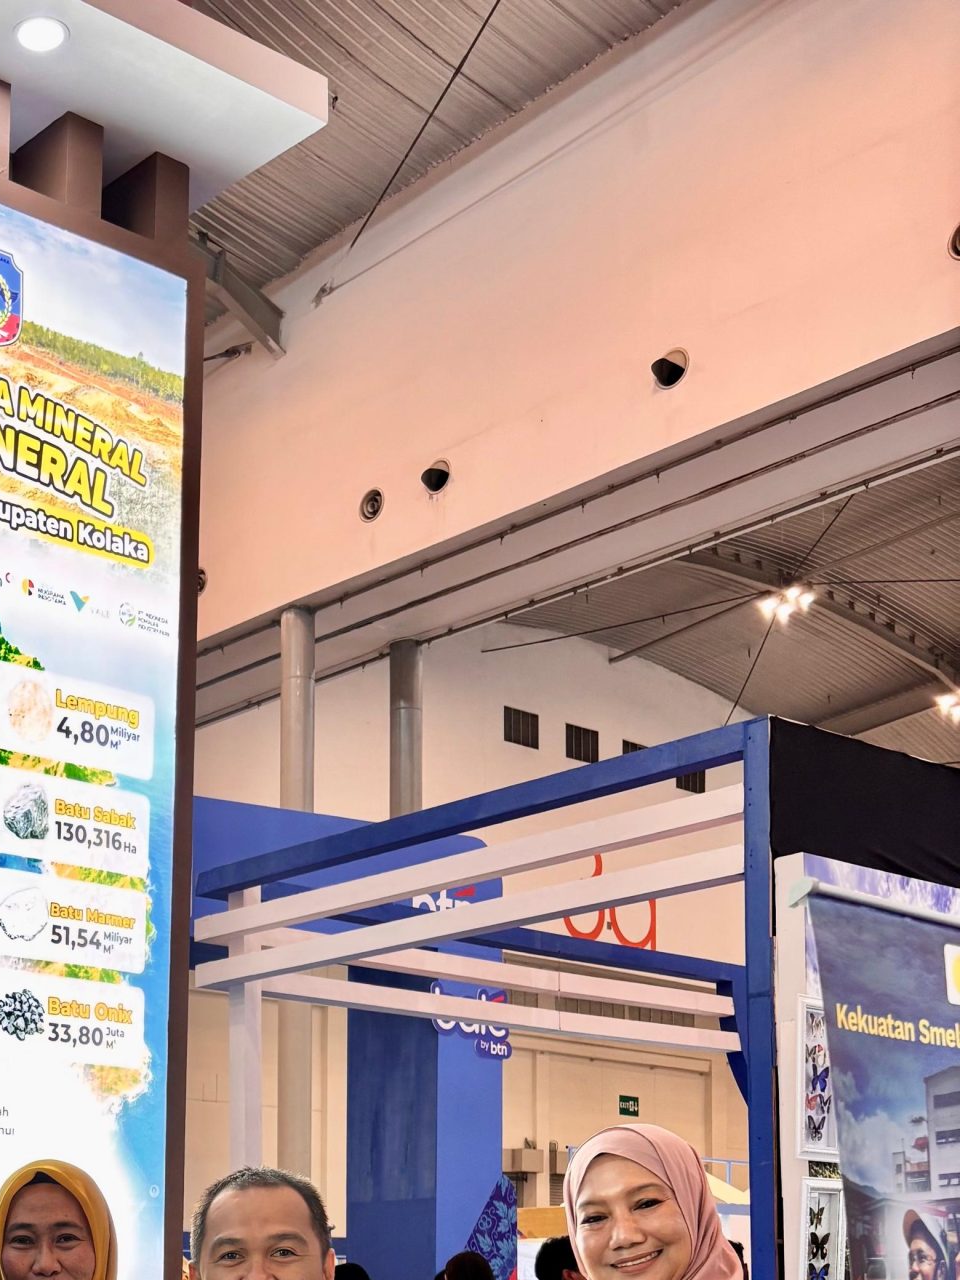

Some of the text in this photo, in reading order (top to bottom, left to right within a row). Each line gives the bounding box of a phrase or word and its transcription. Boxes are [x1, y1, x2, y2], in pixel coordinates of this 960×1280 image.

[18, 387, 147, 487] MINERAL
[77, 521, 150, 563] Kolaka
[55, 688, 140, 730] Lempung
[56, 716, 140, 747] 4,80 Miliyar
[55, 798, 137, 830] Batu Sabak
[55, 820, 137, 854] 130,316 Ha
[50, 902, 136, 929] Batu Marmer
[50, 924, 133, 951] 51,54 Miliyar
[47, 996, 133, 1025] Batu Onix
[836, 1003, 960, 1049] Kekuatan Smel
[48, 1022, 125, 1048] 33,80 Juta
[480, 1039, 508, 1057] by btn
